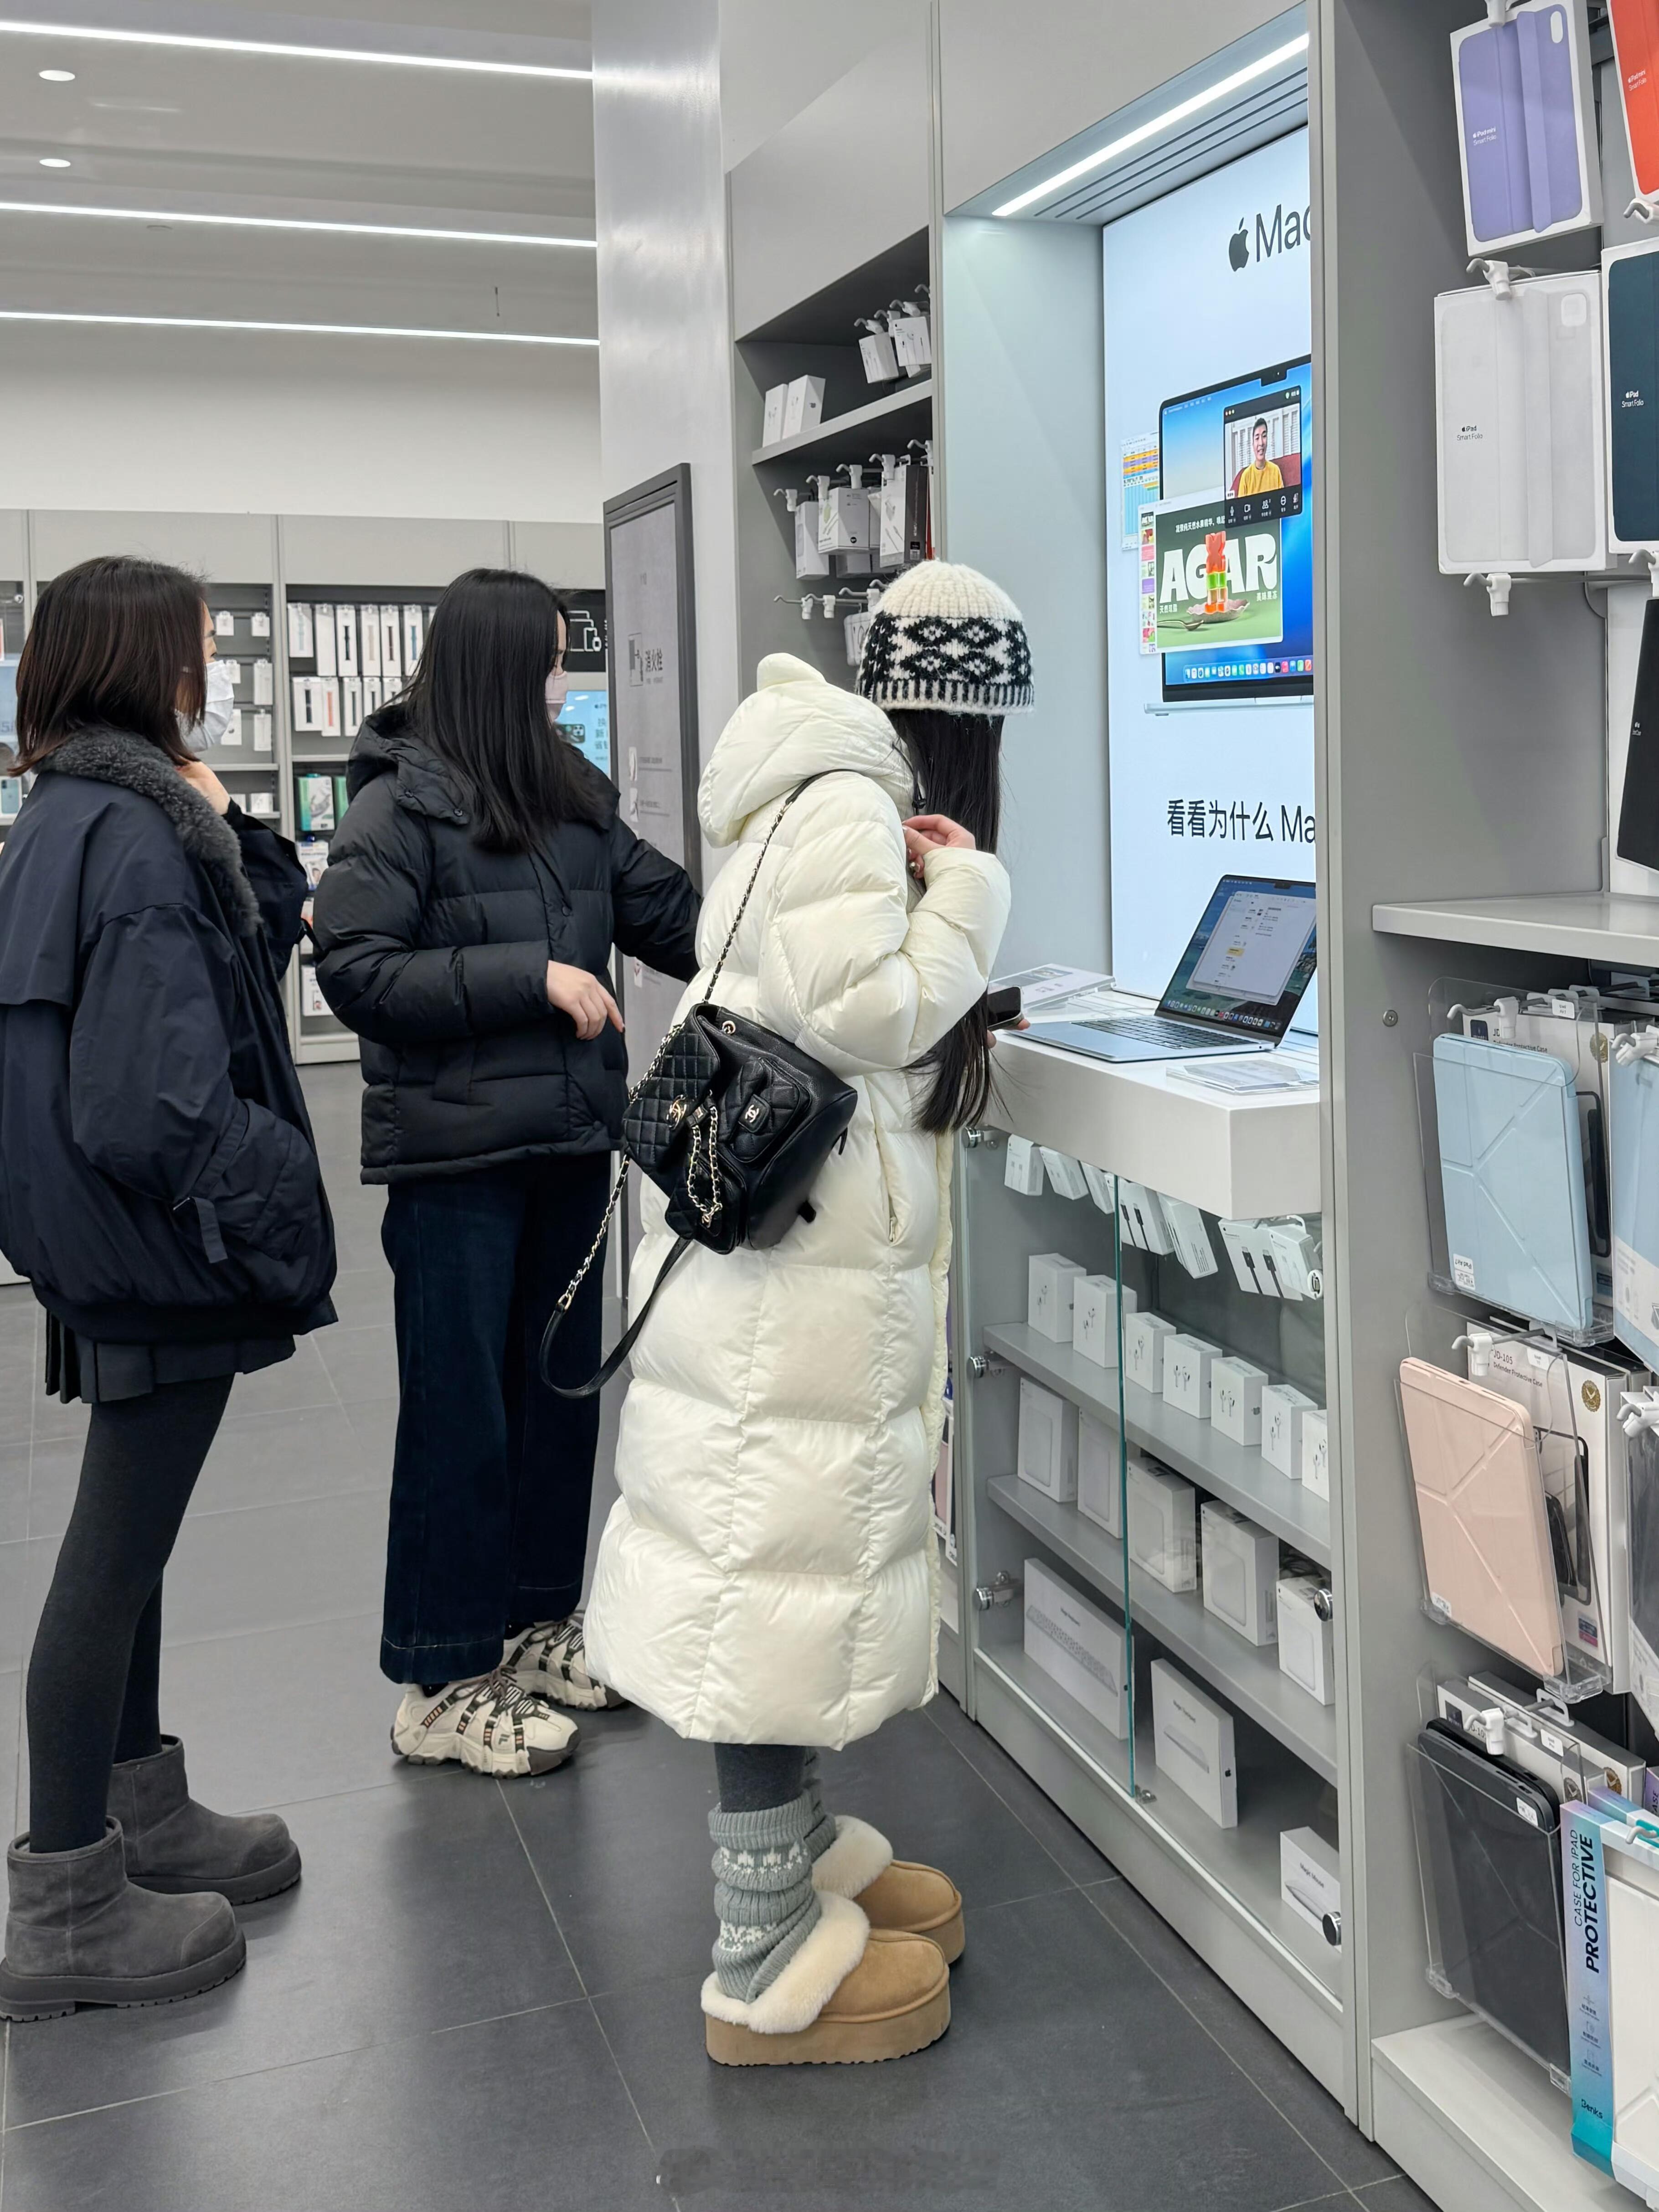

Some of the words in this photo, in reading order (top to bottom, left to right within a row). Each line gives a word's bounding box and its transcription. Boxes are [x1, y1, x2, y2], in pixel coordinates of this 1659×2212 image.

[1473, 137, 1486, 146] Smart
[1159, 533, 1278, 603] AGAR
[644, 647, 663, 672] 消火栓
[1167, 799, 1274, 842] 看看为什么
[1570, 1829, 1580, 1861] IPAD
[1572, 1863, 1581, 1889] FOR
[1573, 1891, 1582, 1927] CASE
[1579, 1834, 1599, 1974] PROTECTIVE
